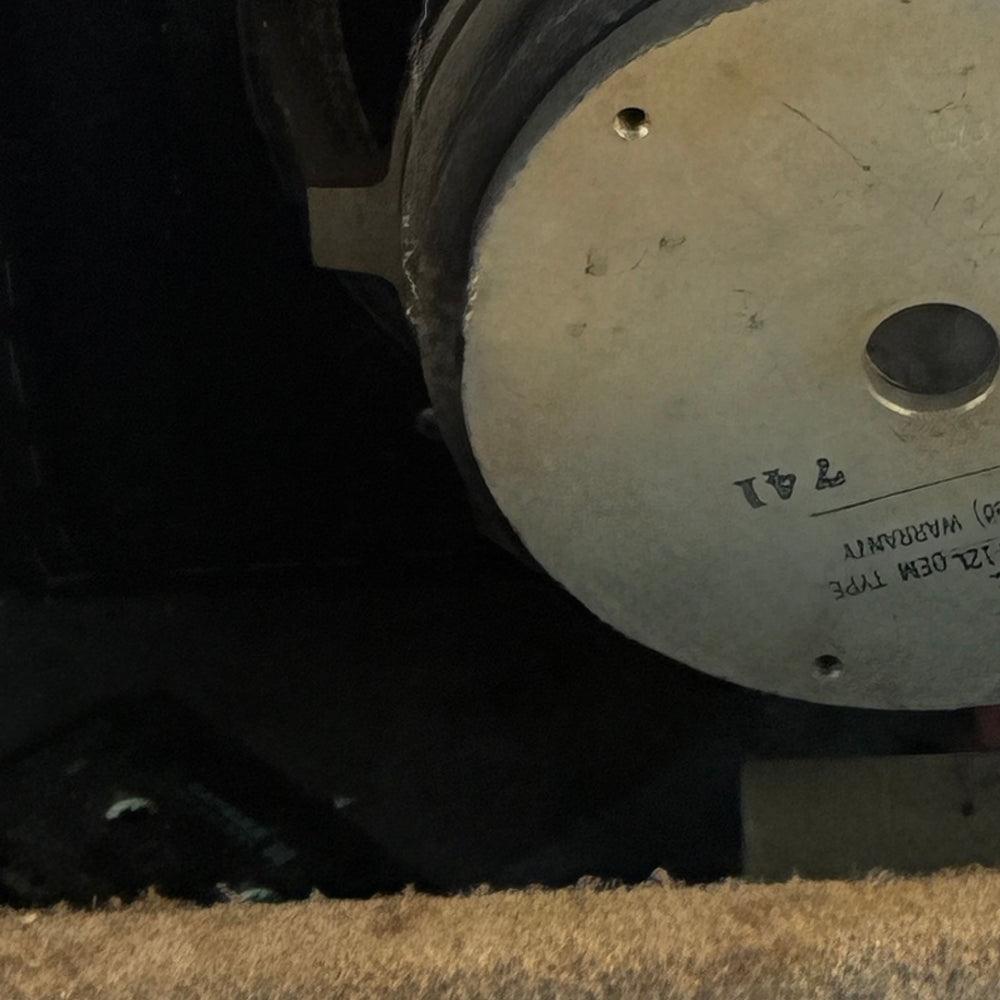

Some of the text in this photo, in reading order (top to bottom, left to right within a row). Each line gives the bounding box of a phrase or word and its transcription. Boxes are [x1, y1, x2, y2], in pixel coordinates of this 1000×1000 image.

[844, 514, 963, 561] WARRANTY
[898, 552, 947, 581] OEM
[828, 569, 888, 600] TYPE
